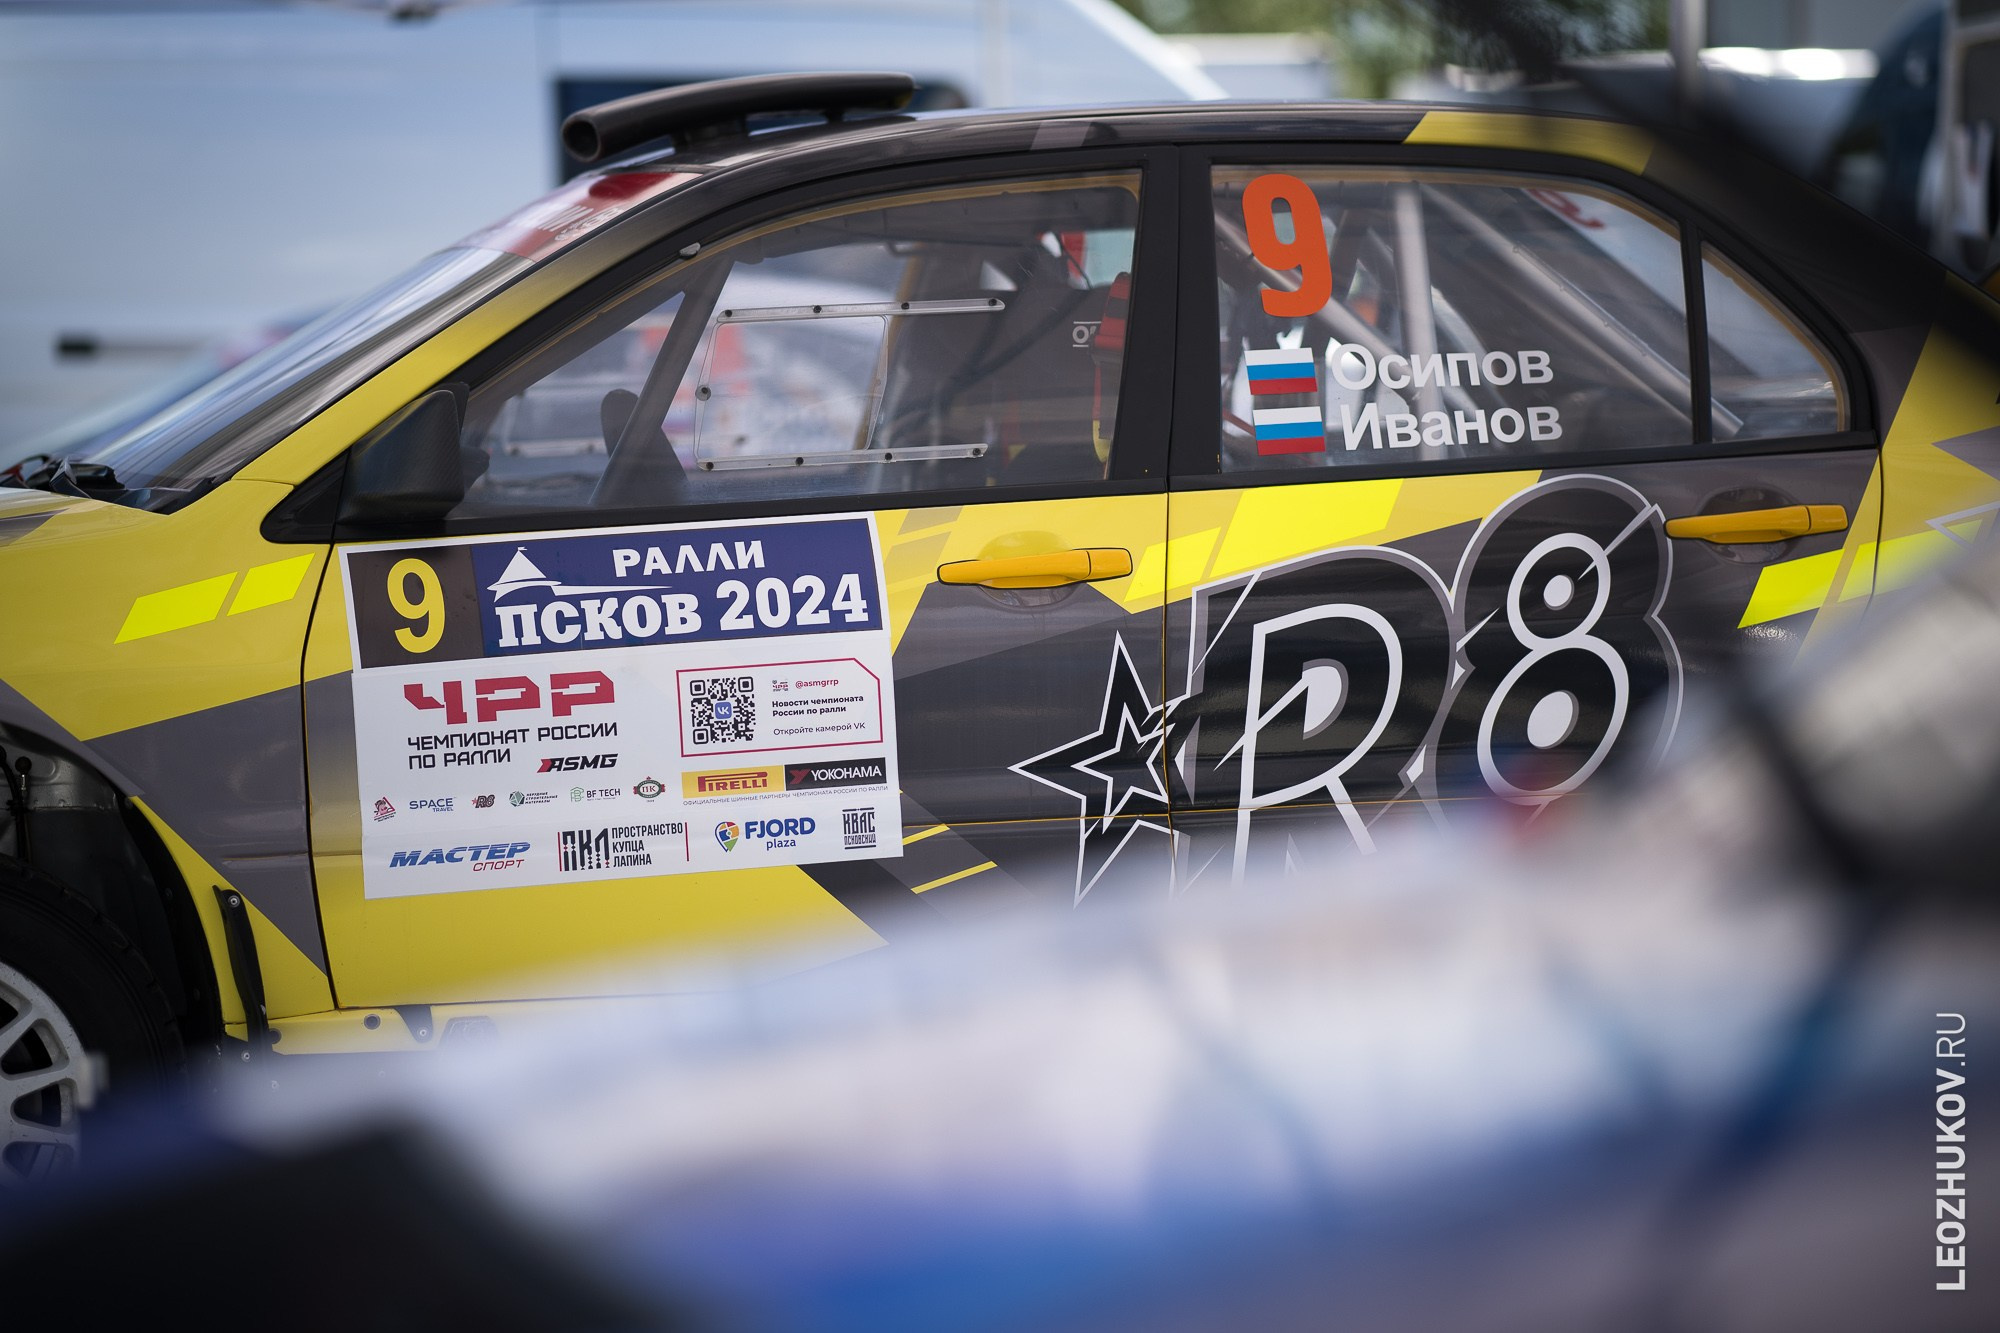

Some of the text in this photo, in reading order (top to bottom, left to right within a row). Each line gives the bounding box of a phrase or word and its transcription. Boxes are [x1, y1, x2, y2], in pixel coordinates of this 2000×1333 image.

[1242, 173, 1332, 317] 9
[1331, 343, 1554, 390] Осипов
[1340, 402, 1563, 451] Иванов
[612, 540, 765, 578] РАЛЛИ
[387, 558, 446, 653] 9
[495, 573, 868, 647] ПСКОВ 2024
[795, 678, 839, 691] @asmgrrp
[404, 671, 615, 725] ЧРР
[772, 695, 864, 708] Новости чемпионата
[772, 708, 805, 717] России
[819, 706, 847, 716] ралли
[407, 722, 618, 751] ЧЕМПИОНАТ РОССИИ
[773, 722, 866, 736] Откройте камерой VK
[409, 748, 511, 770] ПО РАЛЛИ
[543, 753, 618, 772] ASMG
[697, 771, 768, 793] PIRELLI
[810, 765, 882, 782] YOKOHAMA
[586, 788, 621, 798] BF TECH
[683, 797, 730, 806] ОФИЦИАЛЬНЫЕ
[793, 790, 833, 798] ЧЕМПИОНАТА
[409, 798, 454, 810] SPACE
[611, 822, 683, 839] ПРОСТРАНСТВО
[744, 817, 815, 840] FJORD
[842, 811, 876, 835] КВАС
[612, 840, 645, 854] КУПЦА
[766, 838, 796, 851] plaza
[389, 841, 531, 868] МАСТЕР
[613, 853, 652, 868] ЛАПИНА
[472, 859, 525, 872] СПОРТ
